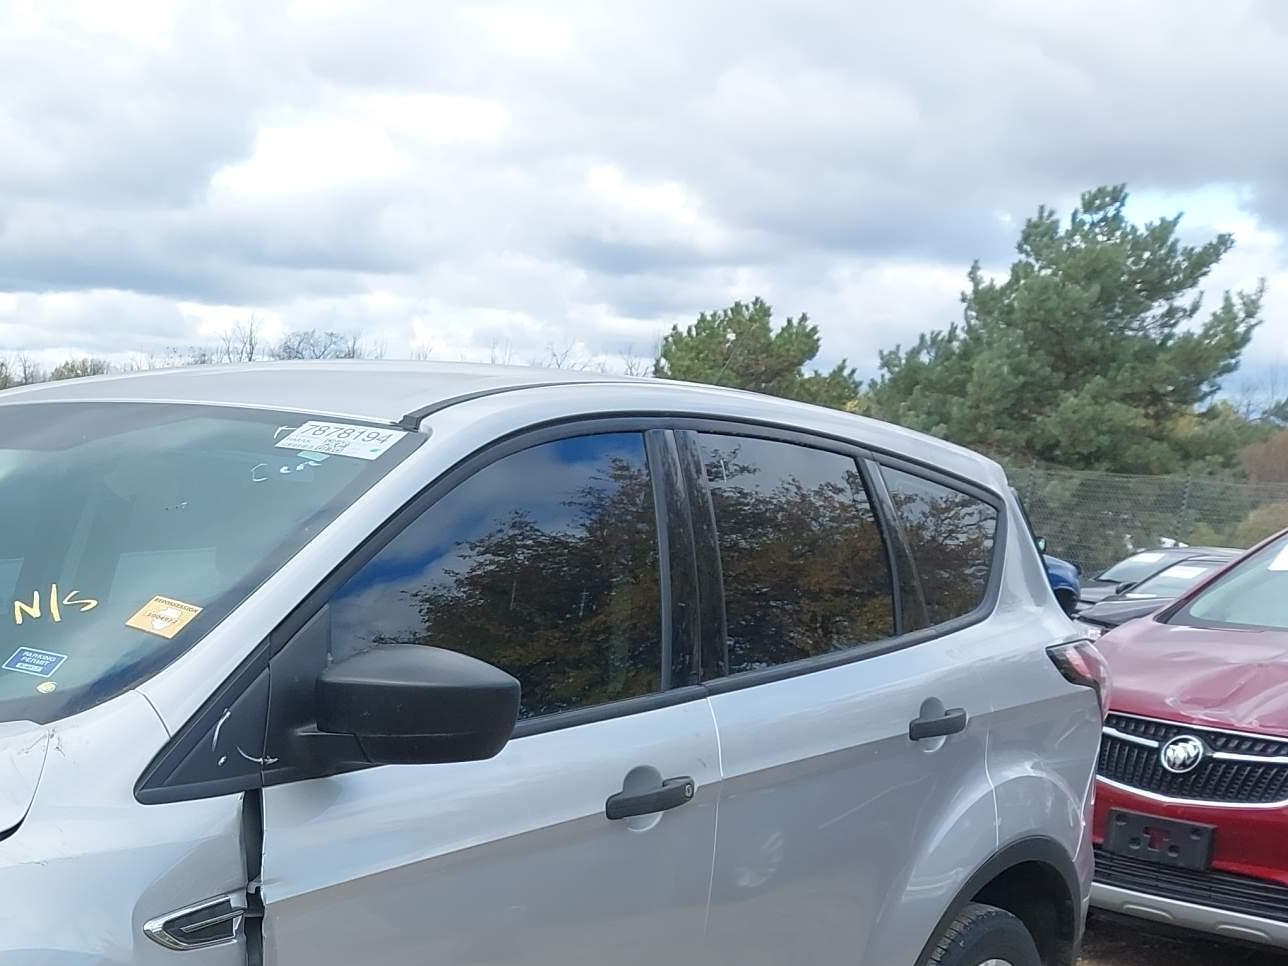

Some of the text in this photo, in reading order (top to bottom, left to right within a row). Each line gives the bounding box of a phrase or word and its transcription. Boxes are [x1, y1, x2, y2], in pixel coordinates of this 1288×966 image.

[300, 424, 393, 445] 7878194
[20, 656, 51, 666] PERMIT
[22, 650, 57, 662] PARKING
